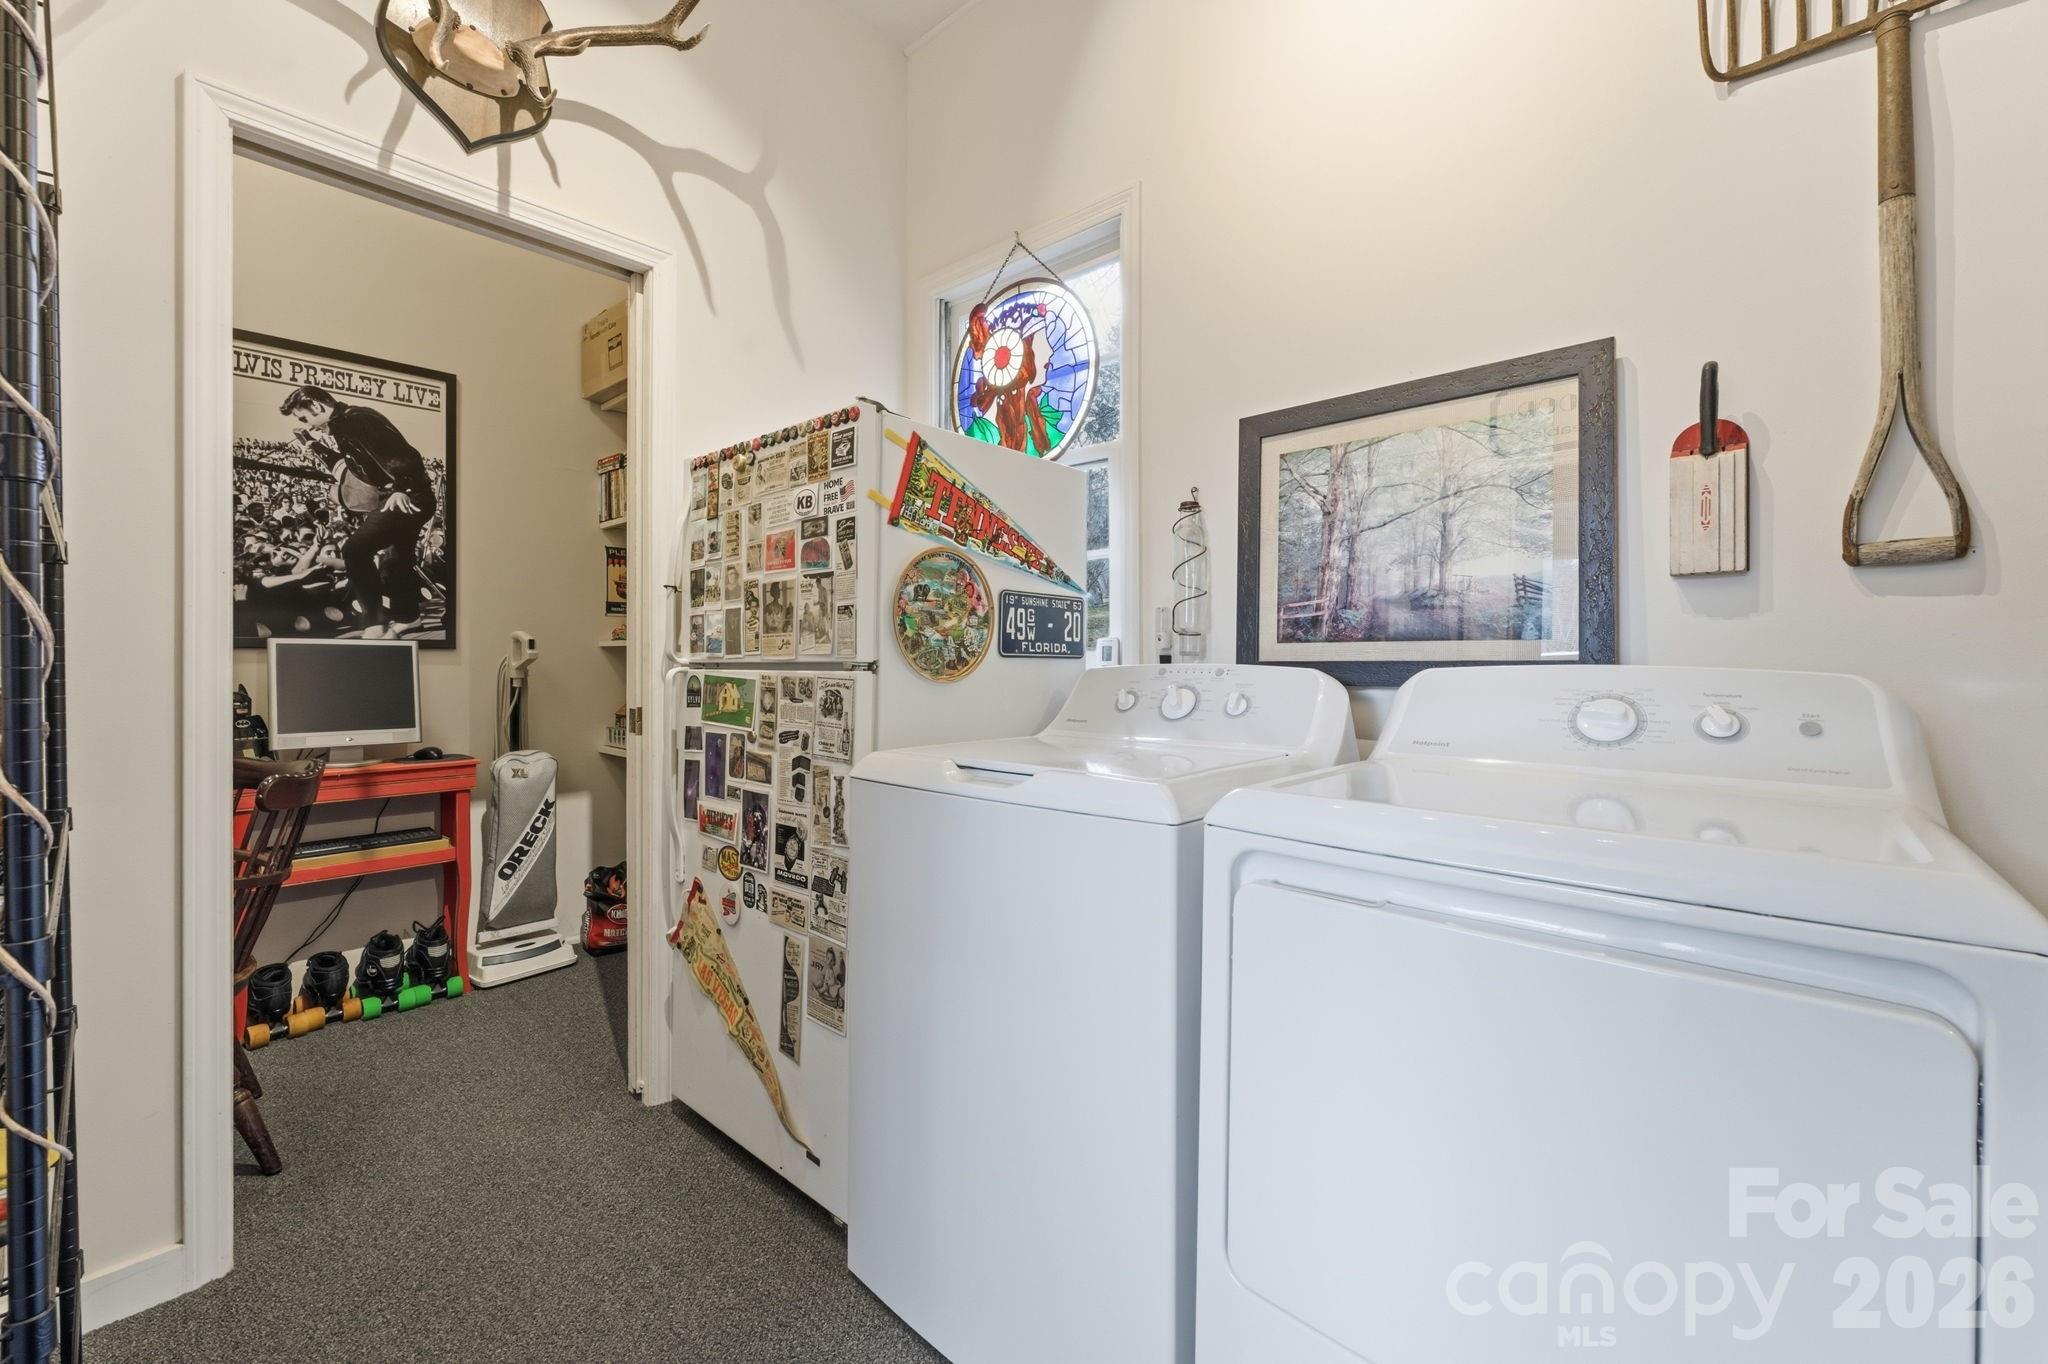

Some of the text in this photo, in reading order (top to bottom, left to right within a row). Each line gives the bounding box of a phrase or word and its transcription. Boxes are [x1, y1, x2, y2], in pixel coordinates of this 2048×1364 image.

[289, 361, 387, 398] PRESLEY
[393, 382, 441, 409] LIVE
[823, 477, 844, 490] HOME
[796, 494, 813, 510] KB
[823, 492, 839, 503] FREE
[823, 503, 845, 516] BRAVE
[1005, 594, 1082, 611] 19 SUNSHINE STATE 63
[1006, 607, 1025, 640] 49
[1063, 611, 1081, 642] 20
[1021, 642, 1068, 653] FLORIDA
[511, 768, 530, 779] XL
[497, 798, 556, 881] ORECK
